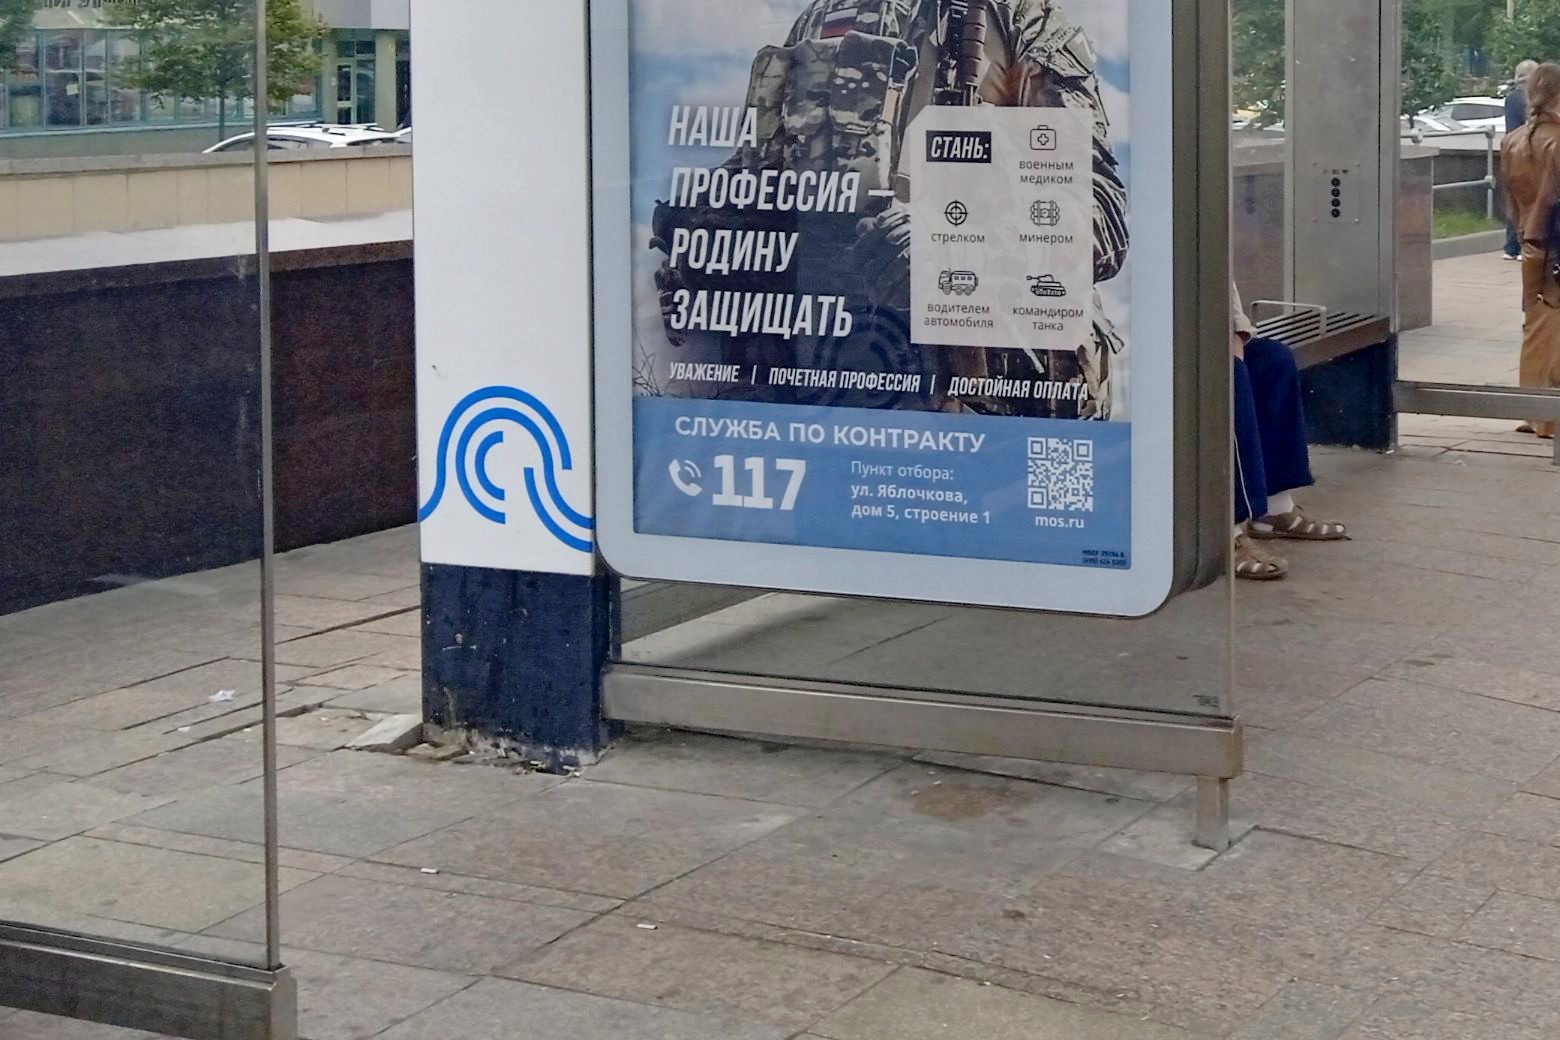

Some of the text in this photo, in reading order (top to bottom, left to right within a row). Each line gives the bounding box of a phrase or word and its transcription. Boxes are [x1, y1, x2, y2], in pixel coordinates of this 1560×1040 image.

[668, 105, 758, 148] НАША
[930, 135, 990, 160] СТАНЬ:
[1019, 160, 1074, 171] военным
[669, 166, 862, 213] ПРОФЕССИЯ
[1019, 174, 1073, 186] медиком
[931, 232, 985, 244] стрелком
[1019, 233, 1074, 245] минером
[669, 227, 799, 276] РОДИНУ
[670, 288, 853, 340] ЗАЩИЩАТЬ
[927, 303, 990, 315] водителем
[1013, 307, 1084, 320] командиром
[924, 315, 994, 329] автомобиля
[1032, 321, 1064, 332] танка
[668, 361, 1089, 401] УВАЖЕНИЕ ПОЧЕТНАЯ ПРОФЕССИЯ ДОСТОЙНАЯ ОПЛАТА
[675, 416, 986, 453] СЛУЖБА ПО КОНТРАКТУ
[850, 460, 954, 483] Пункт отбора:
[711, 454, 807, 511] 117
[850, 484, 968, 505] ул. Яблочкова,
[851, 504, 990, 524] дом 5, строение 1
[1034, 515, 1085, 529] mos.ru
